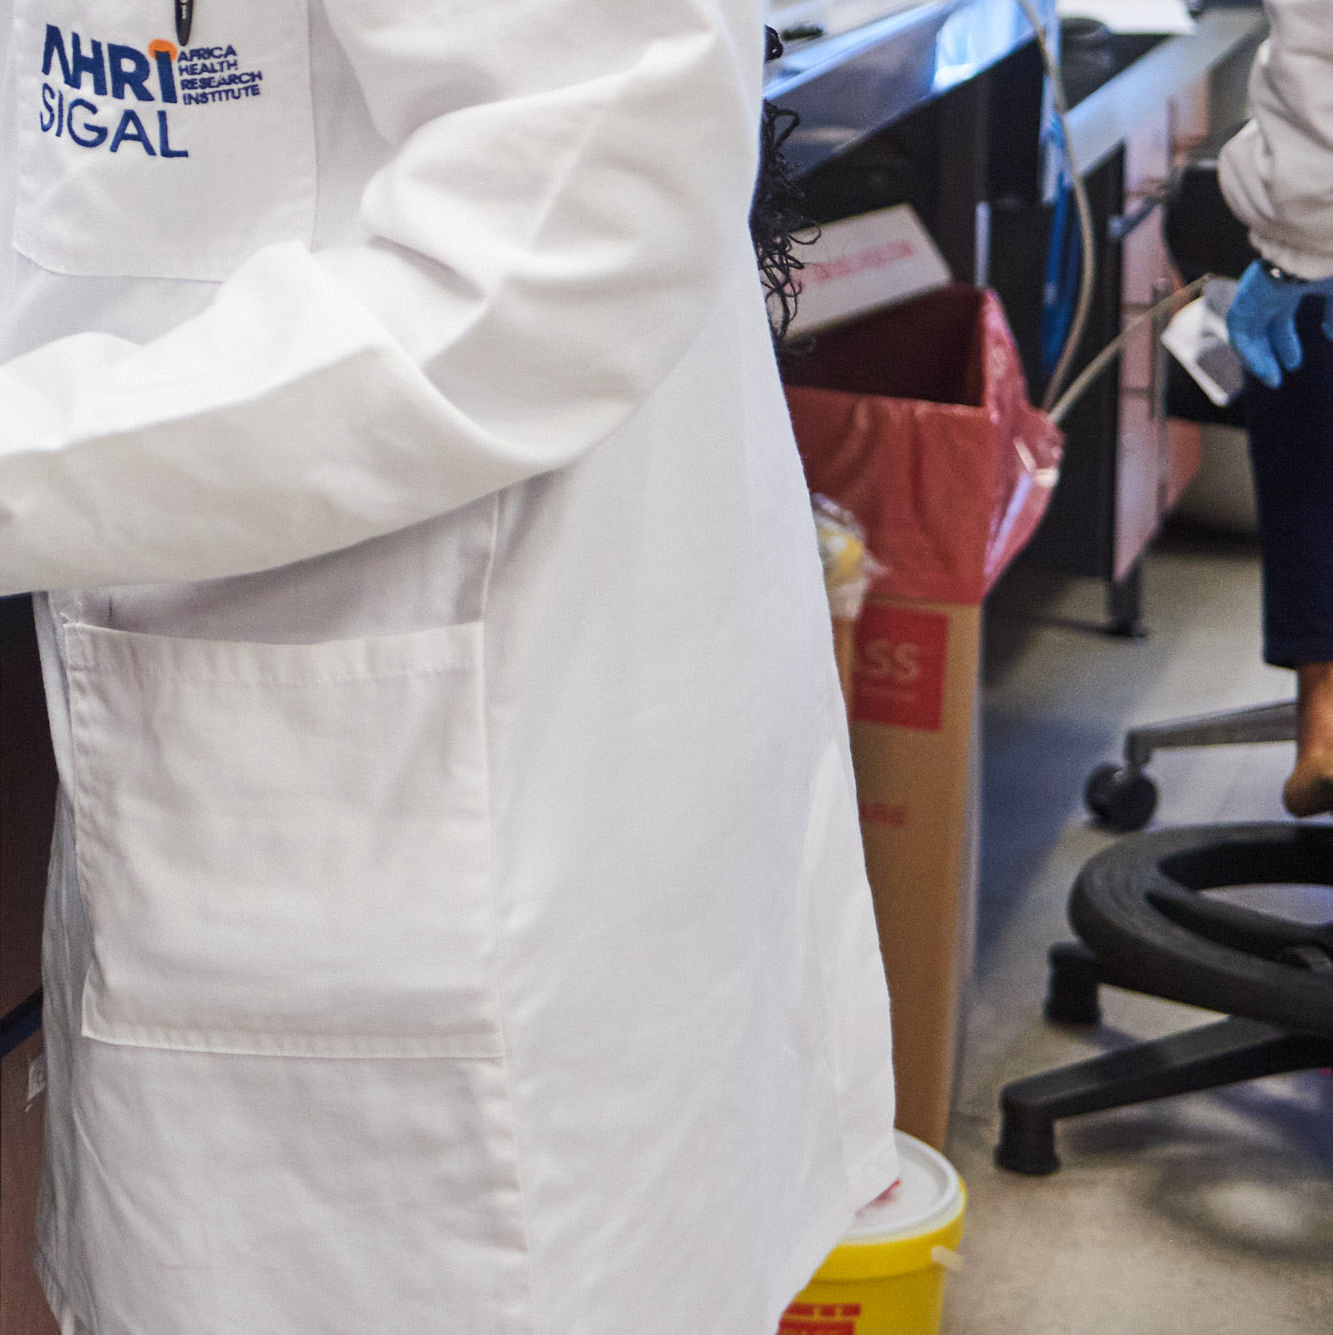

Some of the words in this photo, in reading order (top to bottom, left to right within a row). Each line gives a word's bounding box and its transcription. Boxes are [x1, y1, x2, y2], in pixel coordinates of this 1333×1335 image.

[178, 45, 238, 63] AFRICA
[178, 60, 238, 76] HEALTH
[180, 70, 263, 91] RESEARCH
[183, 84, 261, 106] INSTITUTE
[39, 82, 190, 158] SIGAL
